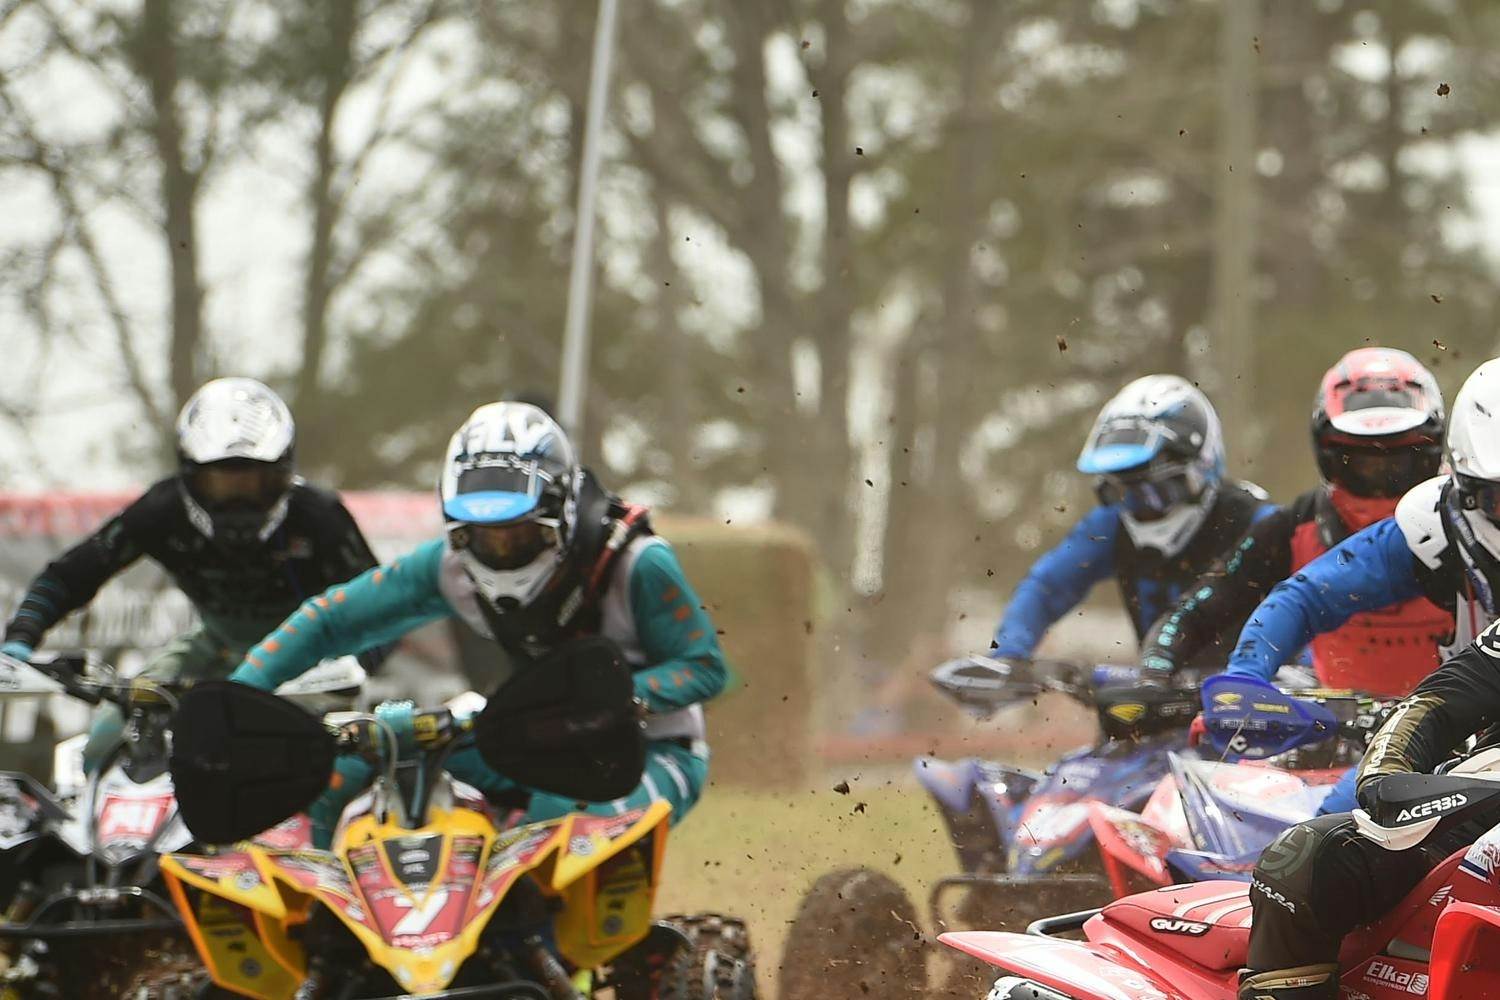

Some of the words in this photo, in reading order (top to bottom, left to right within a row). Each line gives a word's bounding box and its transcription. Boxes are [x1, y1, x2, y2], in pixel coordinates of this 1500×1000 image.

[1395, 793, 1468, 823] ACERBIS
[392, 887, 449, 935] 7
[1150, 918, 1208, 934] GUTS
[1366, 961, 1411, 986] Elka
